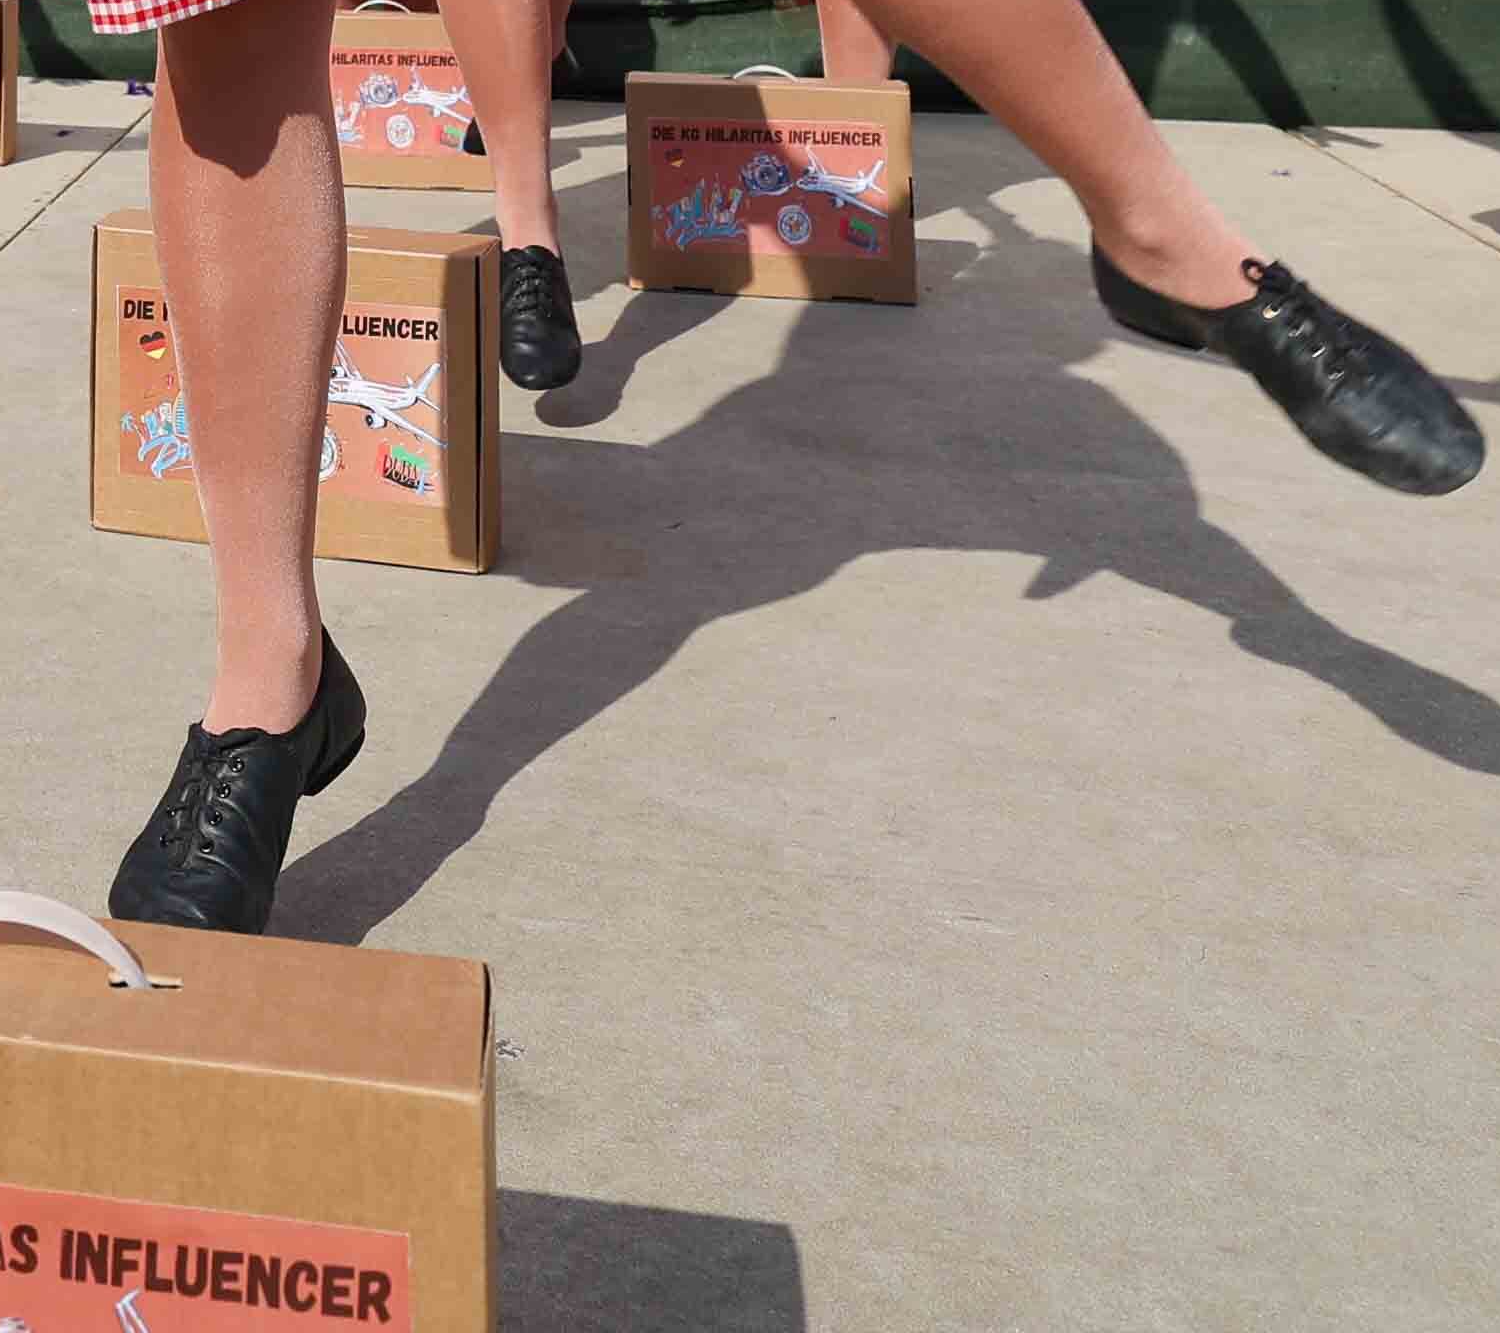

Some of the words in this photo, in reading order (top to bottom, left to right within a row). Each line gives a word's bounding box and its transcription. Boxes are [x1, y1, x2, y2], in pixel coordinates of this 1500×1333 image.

[331, 53, 393, 66] HILARITAS
[397, 55, 458, 67] INFLUENC
[705, 127, 783, 144] HILARITAS
[788, 131, 882, 147] INFLUENCER
[123, 299, 155, 321] DIE
[343, 314, 439, 341] LUENCER
[59, 1228, 393, 1324] INFLUENCER
